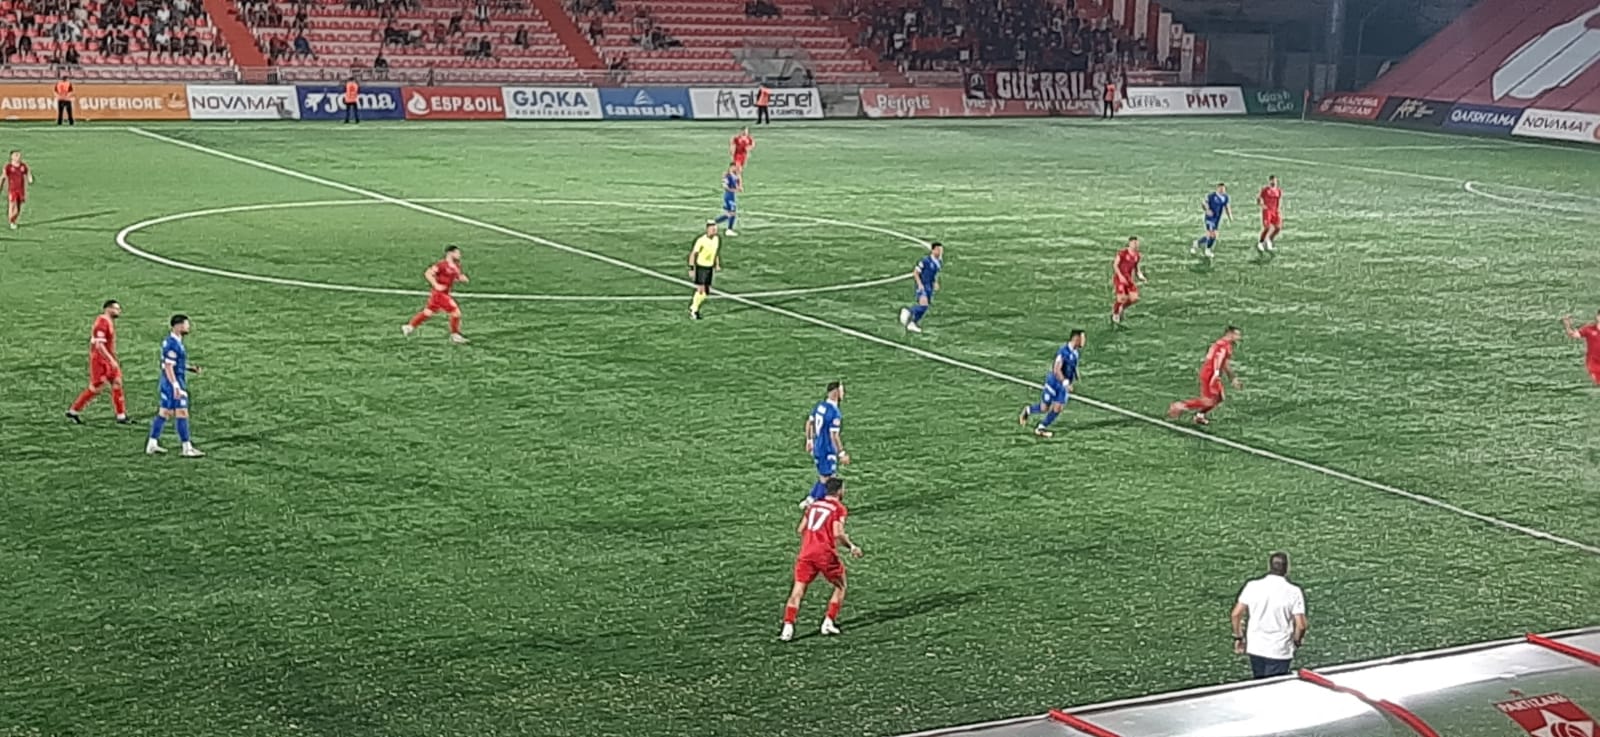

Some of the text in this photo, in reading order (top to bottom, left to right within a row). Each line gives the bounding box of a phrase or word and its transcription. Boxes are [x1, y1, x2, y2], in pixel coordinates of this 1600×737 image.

[79, 97, 162, 110] SUPERIORE
[192, 96, 288, 110] NOVAMAT
[431, 96, 502, 112] ESP&OIL
[513, 90, 588, 108] GJOKA
[1186, 93, 1229, 109] PMTP
[605, 103, 685, 116] tanushi
[1521, 116, 1593, 133] NOVAMAT
[808, 507, 831, 532] 17
